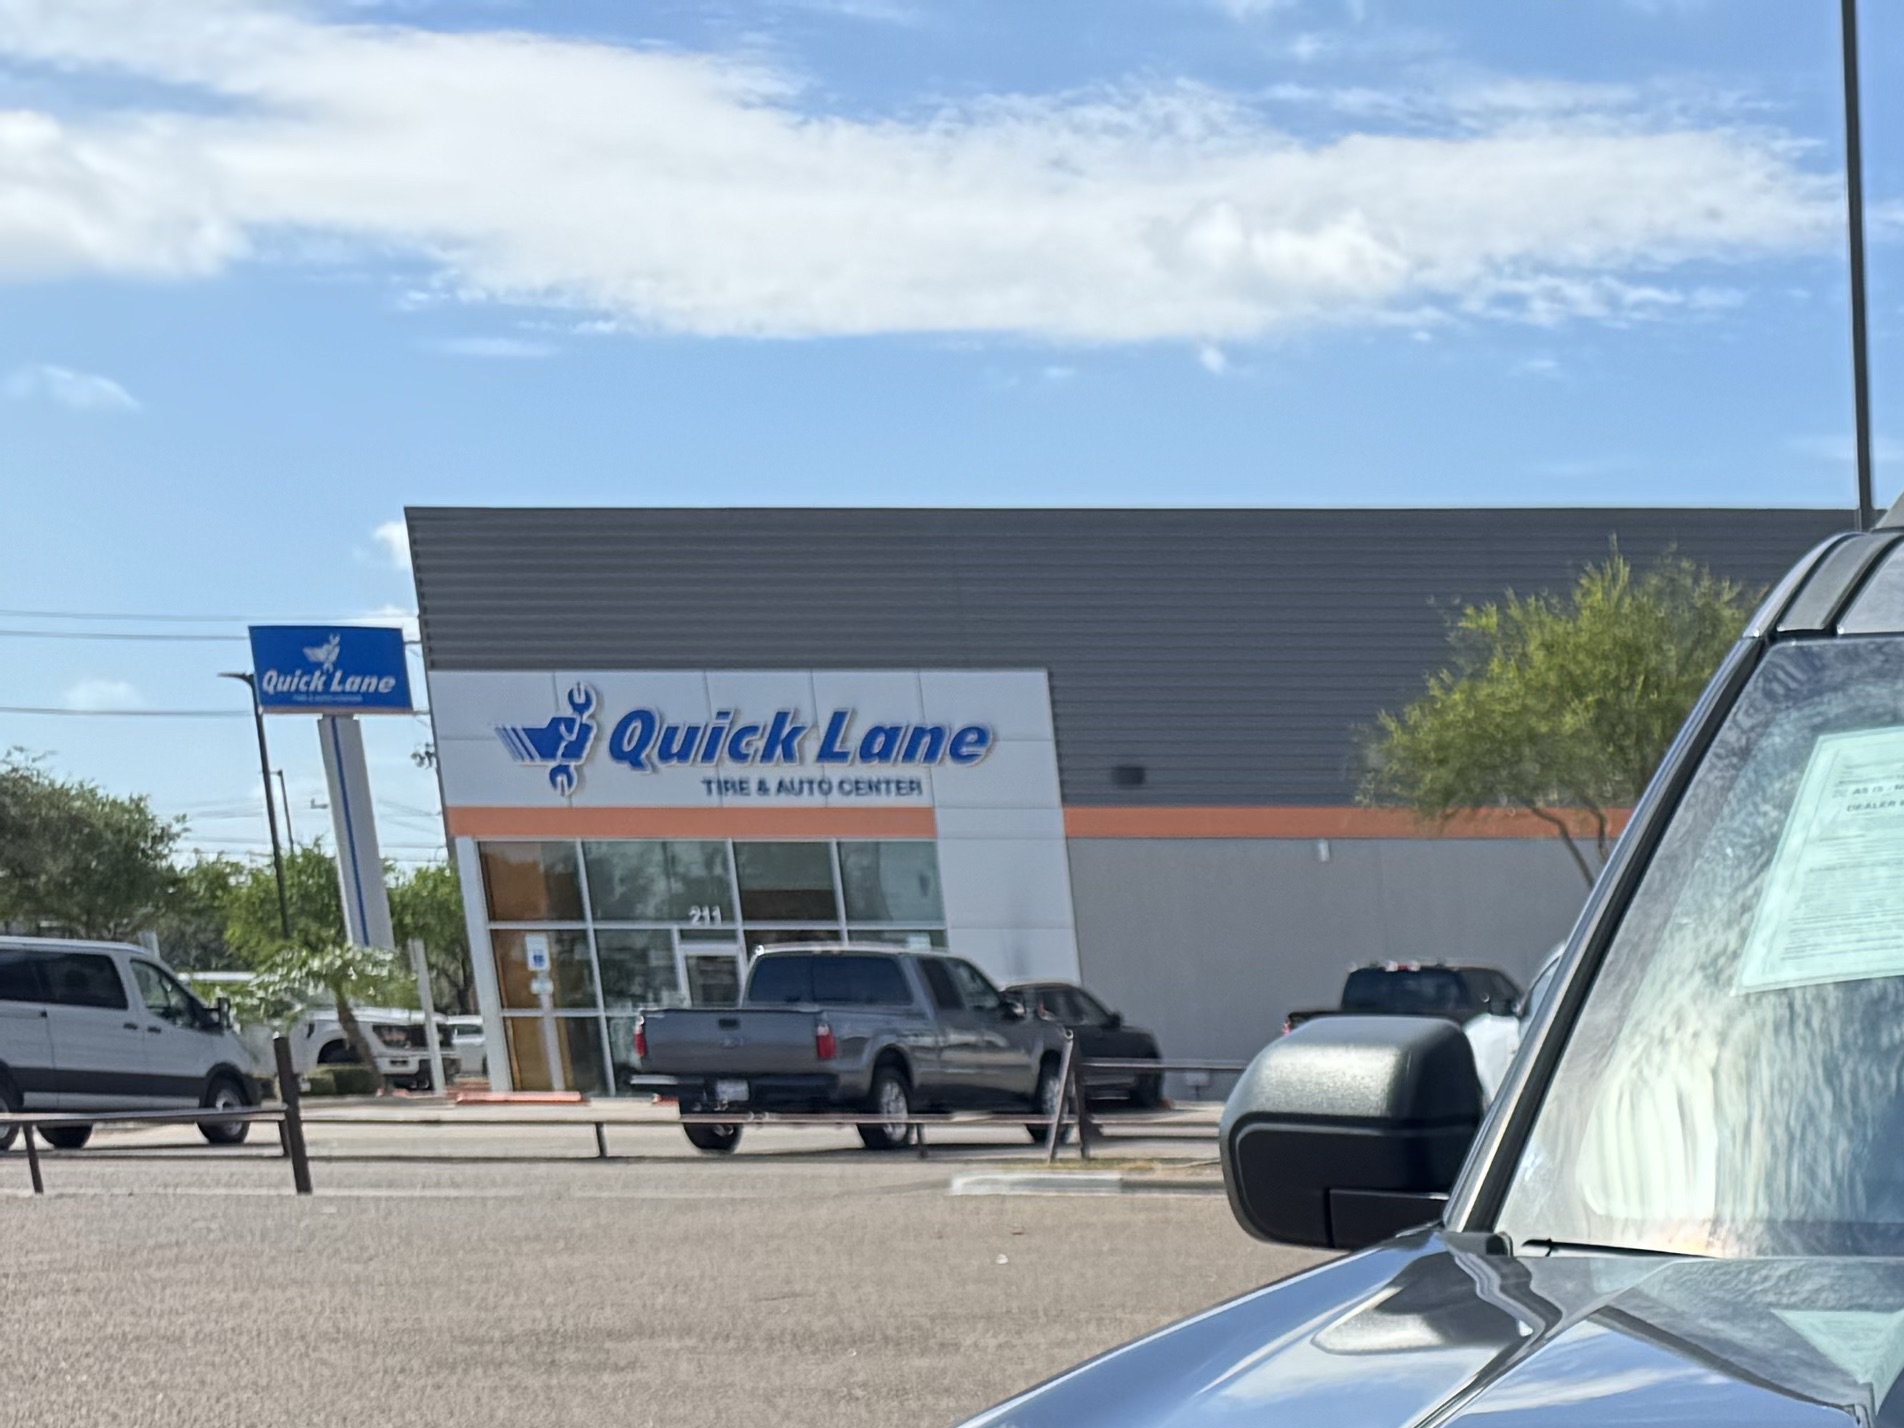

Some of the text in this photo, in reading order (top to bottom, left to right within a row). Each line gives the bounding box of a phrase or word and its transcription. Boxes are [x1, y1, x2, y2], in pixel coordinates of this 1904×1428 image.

[262, 668, 396, 696] Quick Lane
[608, 708, 992, 773] Quick Lane
[701, 776, 923, 798] TIRE & AUTO CENTER
[688, 905, 722, 926] 211
